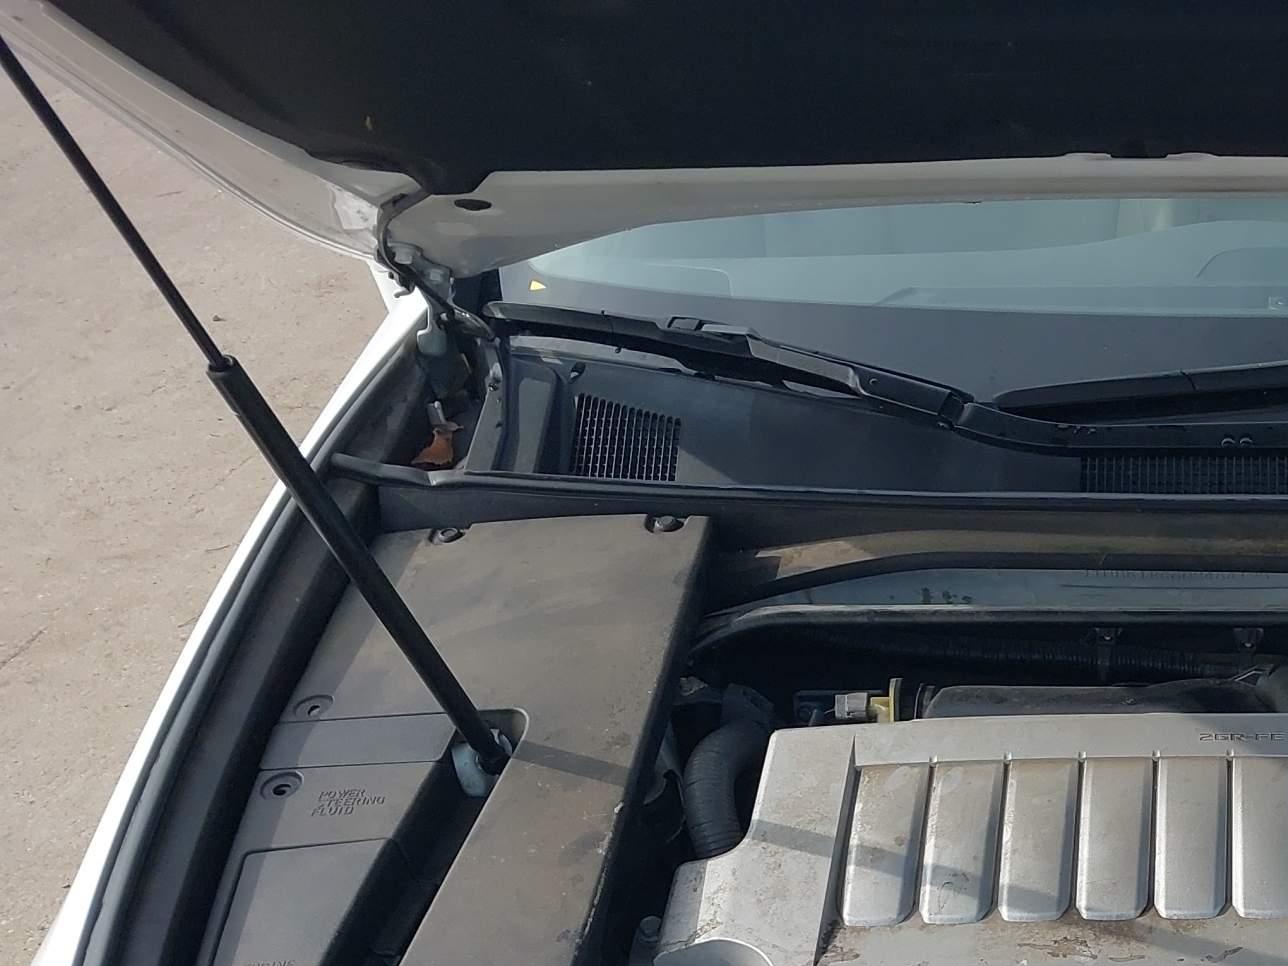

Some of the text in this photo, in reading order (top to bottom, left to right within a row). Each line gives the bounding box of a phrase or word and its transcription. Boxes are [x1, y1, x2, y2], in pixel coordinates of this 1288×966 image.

[1199, 731, 1288, 742] 2GR-FE
[318, 788, 366, 799] POWER
[311, 804, 354, 816] FLUID
